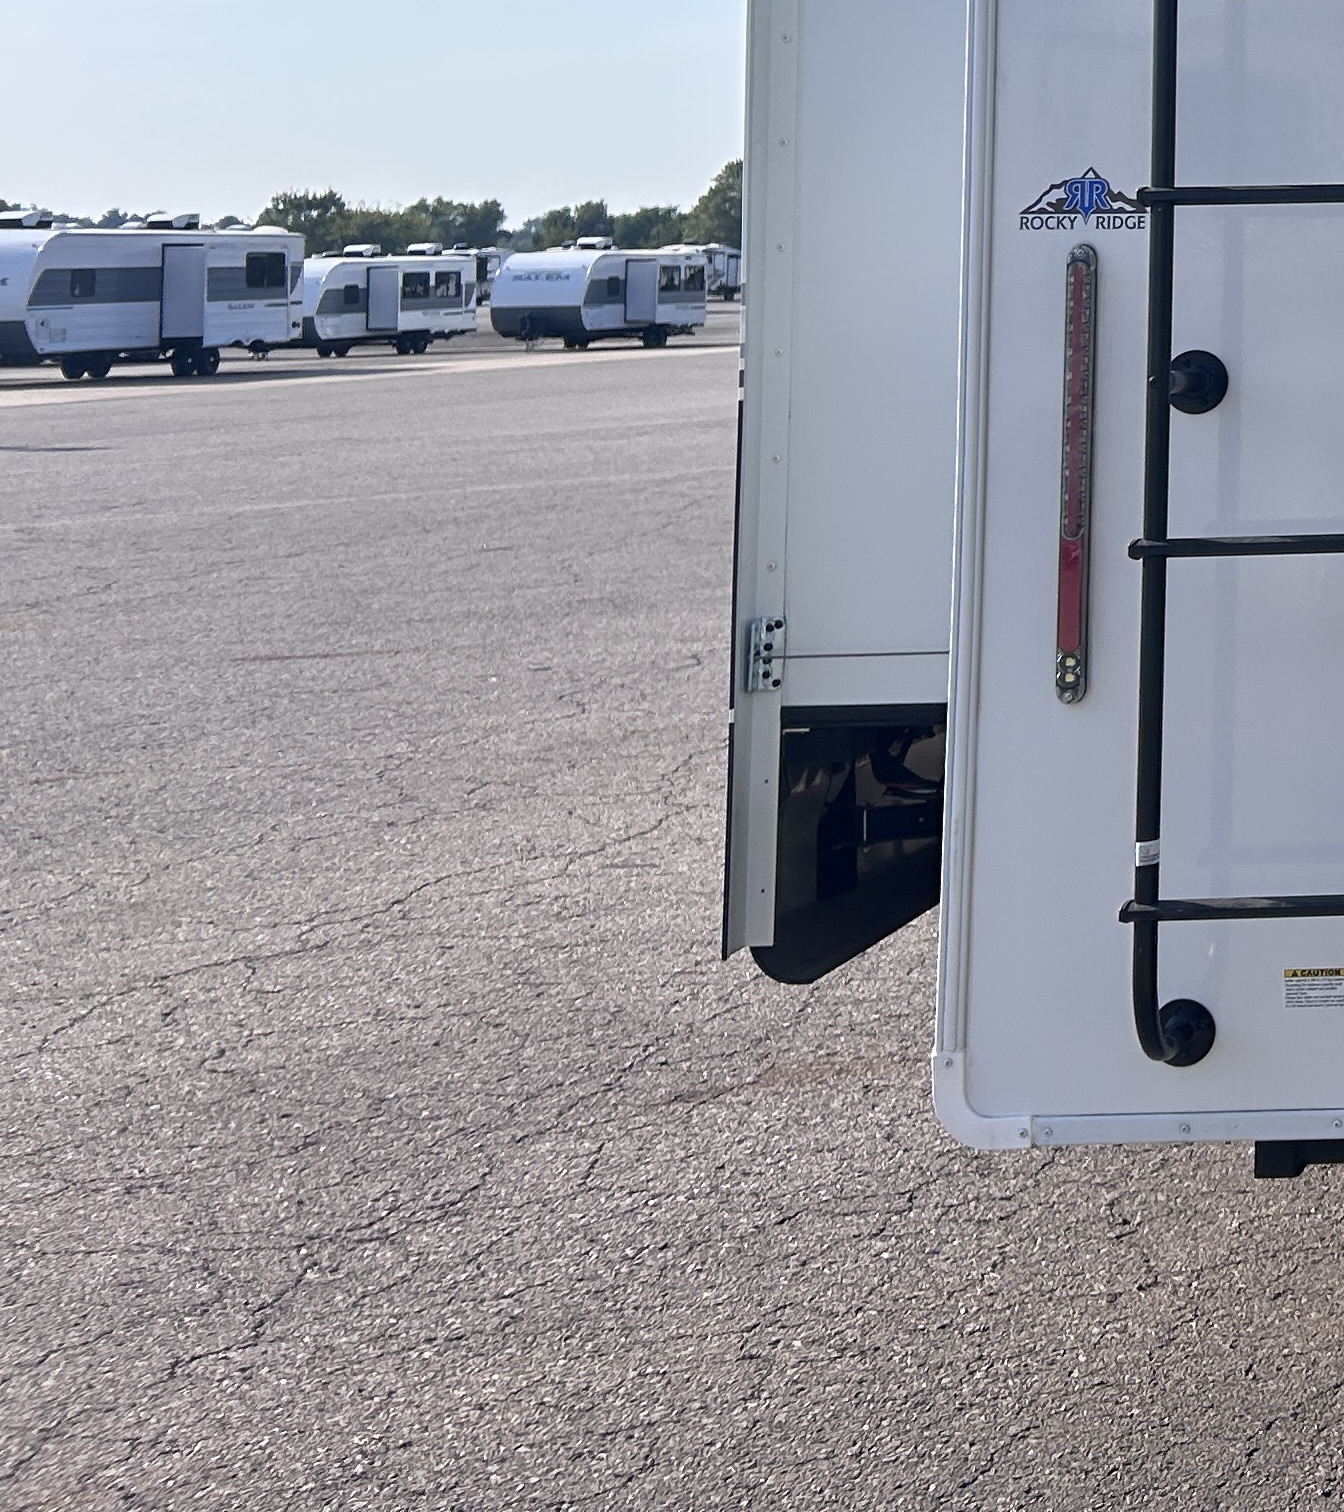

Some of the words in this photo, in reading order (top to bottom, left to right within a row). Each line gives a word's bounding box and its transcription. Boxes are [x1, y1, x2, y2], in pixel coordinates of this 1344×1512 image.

[1019, 215, 1078, 230] ROCKY
[1095, 215, 1146, 230] RIDGE
[1300, 968, 1341, 977] CAUTION
